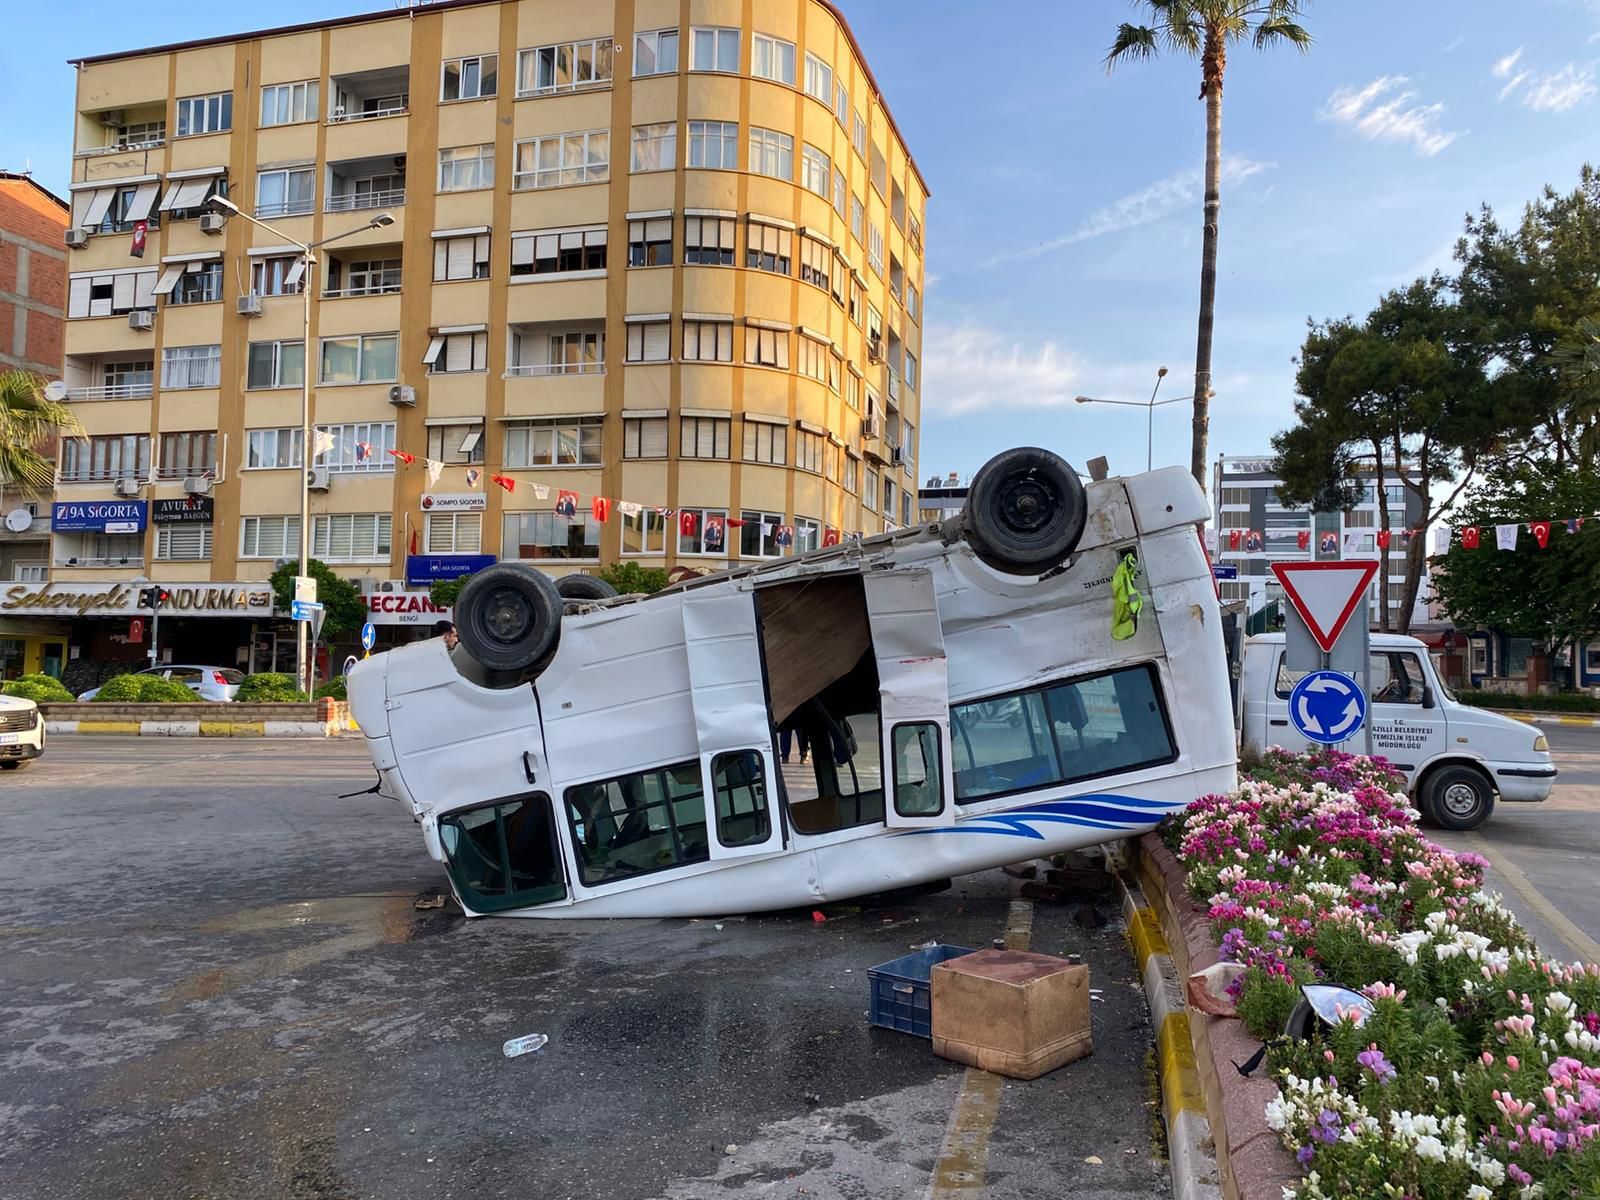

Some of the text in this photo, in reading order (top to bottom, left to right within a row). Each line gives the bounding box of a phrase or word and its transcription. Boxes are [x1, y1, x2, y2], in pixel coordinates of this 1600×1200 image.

[161, 500, 204, 511] AVUKAT
[459, 498, 484, 506] SİGORTA
[70, 504, 140, 518] 9A SİGORTA
[136, 588, 248, 610] DNDURMA
[1378, 741, 1421, 750] MÜDÜRLÜĞÜ
